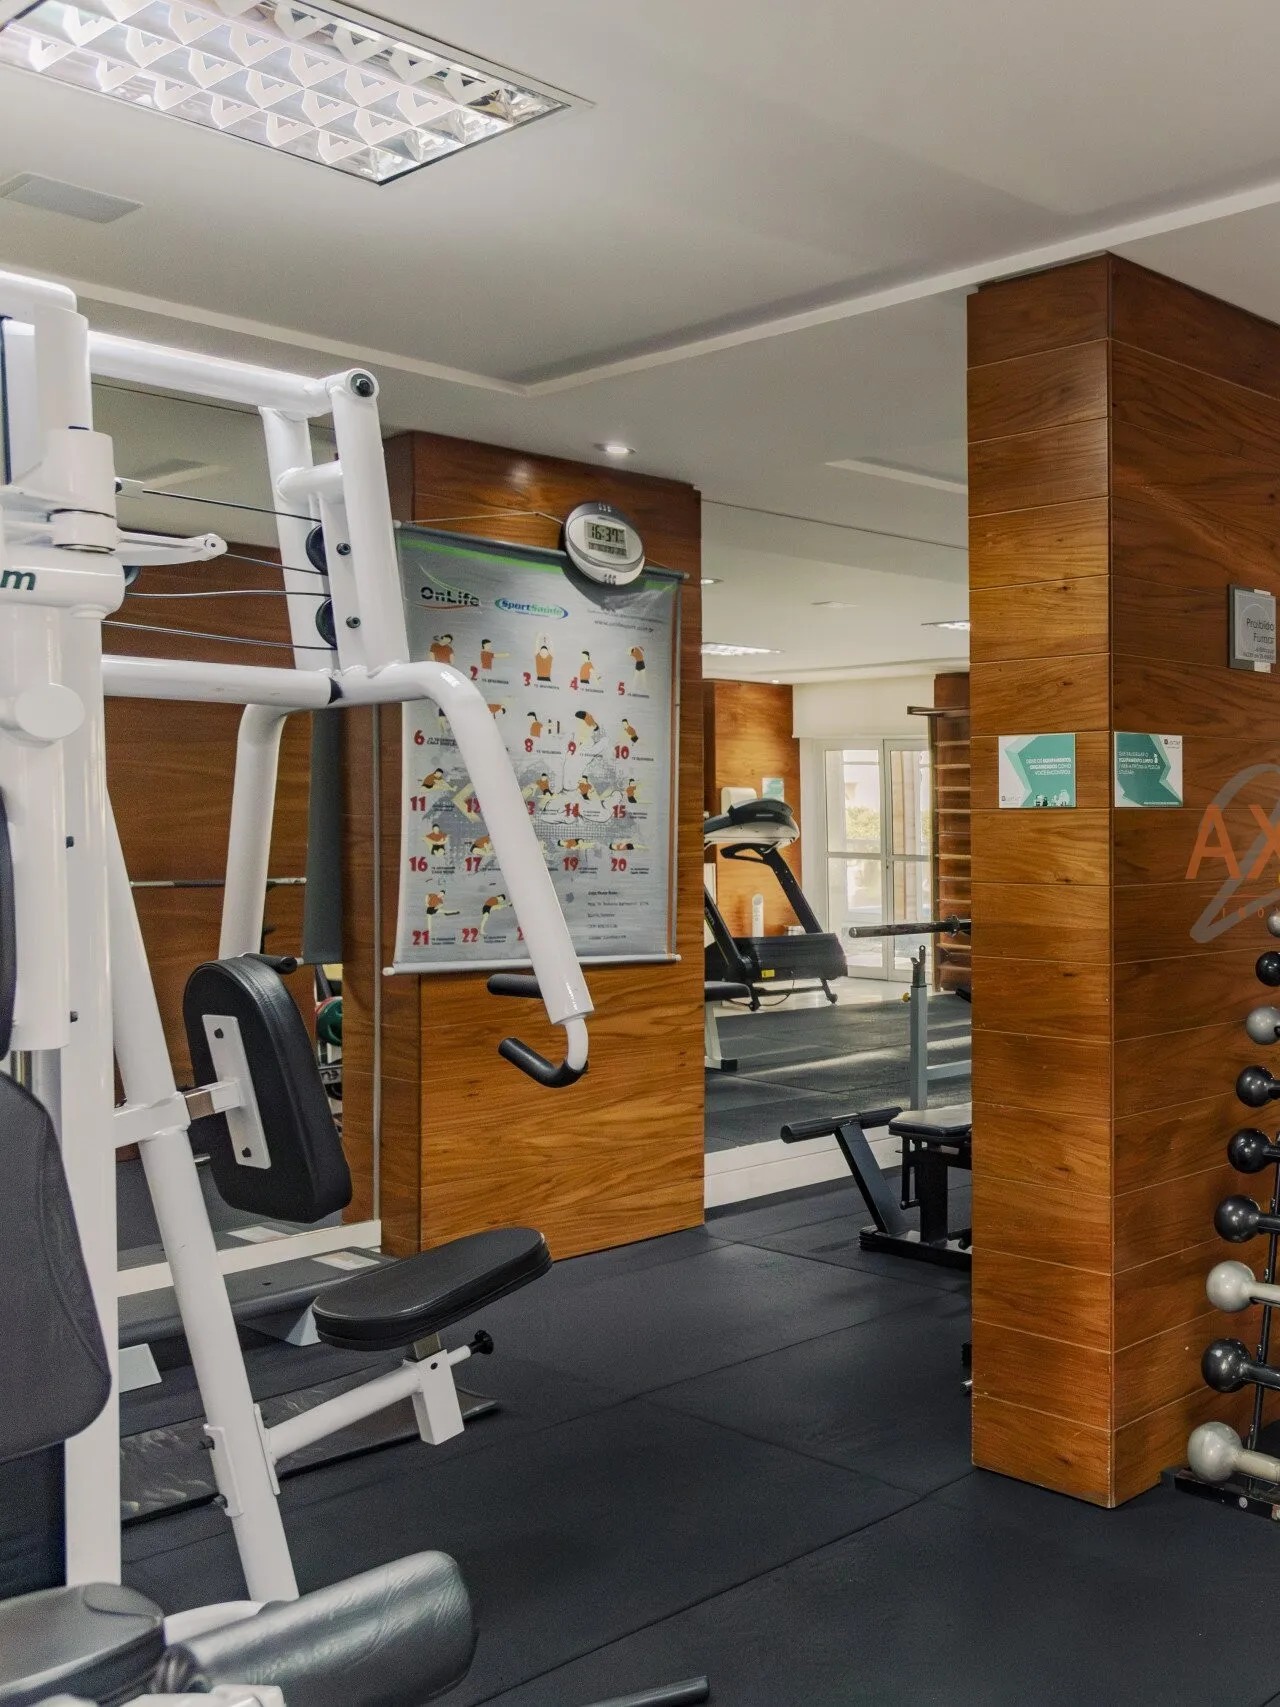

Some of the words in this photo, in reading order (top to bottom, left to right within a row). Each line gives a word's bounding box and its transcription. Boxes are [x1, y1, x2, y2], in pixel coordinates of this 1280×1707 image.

[420, 586, 480, 607] OnLife
[1246, 618, 1274, 631] Proibido
[470, 666, 478, 681] 2
[523, 672, 531, 686] 3
[570, 677, 579, 690] 4
[617, 682, 626, 696] 5
[414, 729, 425, 745] 6
[524, 738, 534, 752] 8
[568, 741, 577, 755] 9
[614, 745, 630, 759] 10
[410, 796, 426, 811] 11
[565, 803, 580, 817] 14
[613, 804, 626, 818] 15
[409, 856, 428, 872] 16
[465, 857, 482, 872] 17
[563, 857, 578, 871] 19
[611, 858, 627, 872] 20
[412, 930, 429, 946] 21
[461, 927, 479, 943] 22
